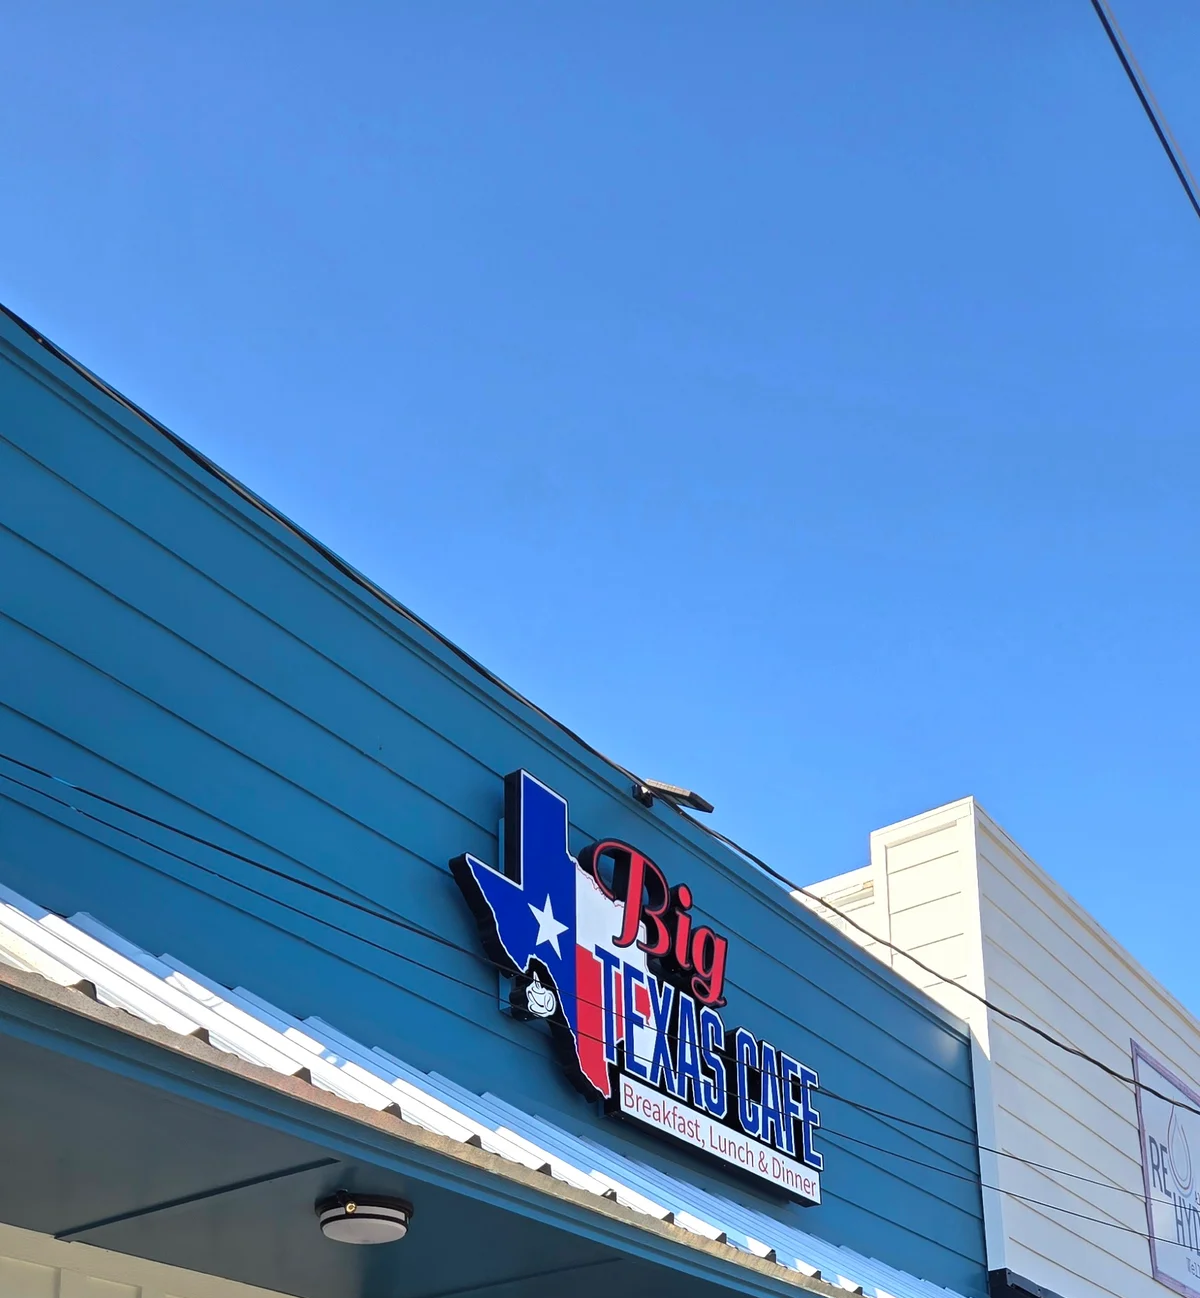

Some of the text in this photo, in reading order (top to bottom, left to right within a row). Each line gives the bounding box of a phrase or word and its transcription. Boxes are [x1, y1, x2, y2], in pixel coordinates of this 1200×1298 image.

[593, 838, 727, 1007] Big
[594, 945, 824, 1172] TEXAS CAFE
[623, 1082, 817, 1197] Breakfast, Lunch & Dinner
[1148, 1135, 1172, 1198] RE
